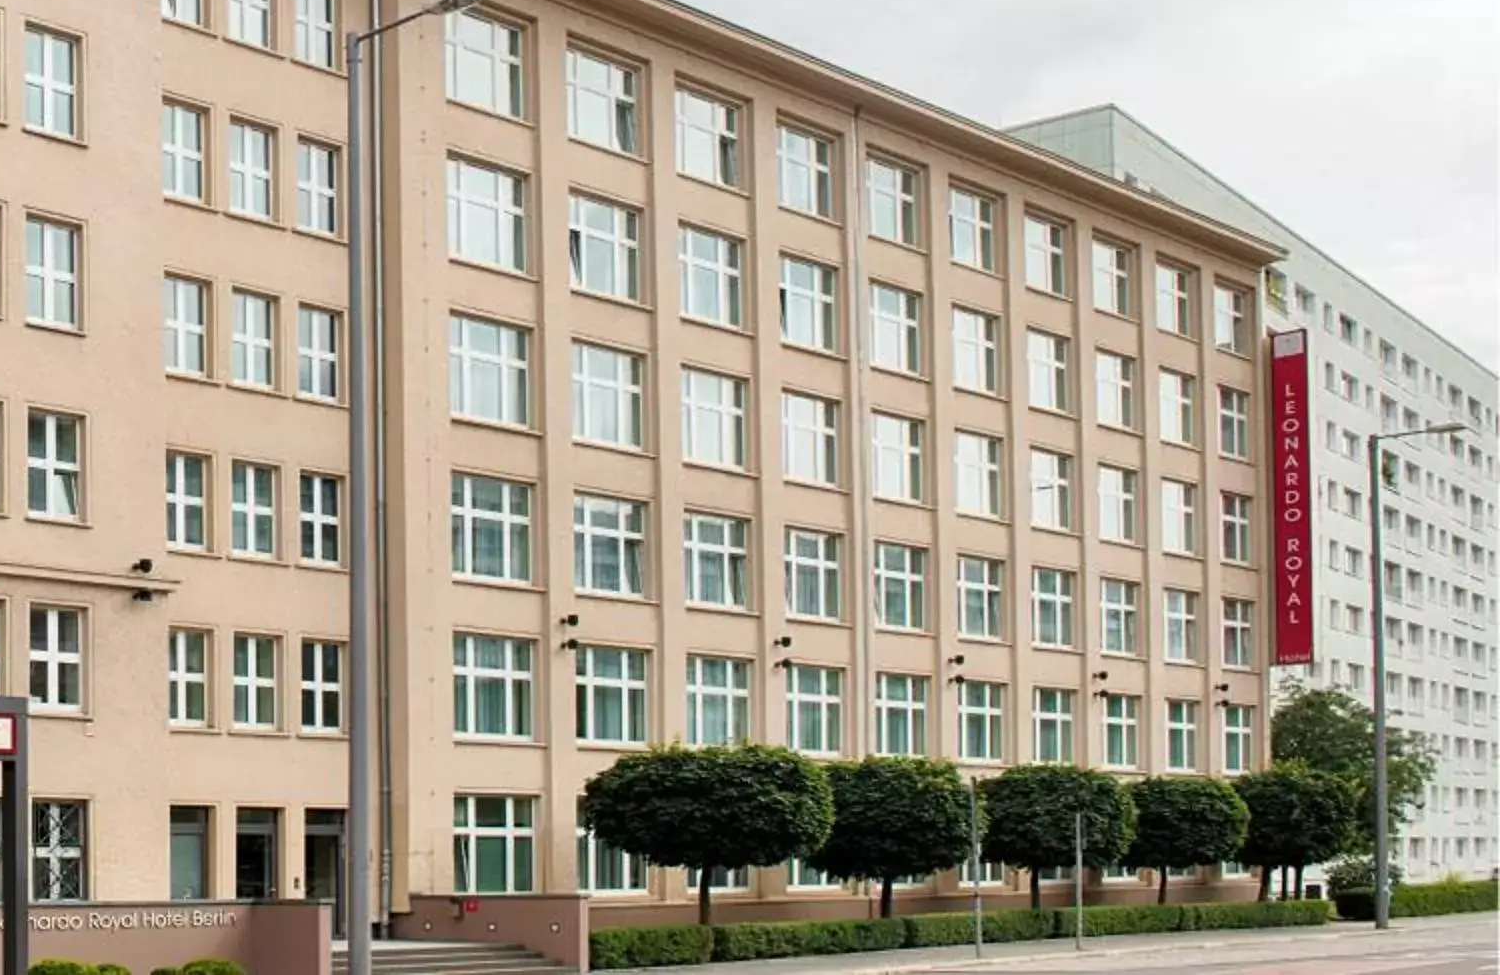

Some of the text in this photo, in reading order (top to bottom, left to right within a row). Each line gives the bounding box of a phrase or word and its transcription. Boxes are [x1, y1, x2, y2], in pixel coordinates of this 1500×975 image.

[1282, 383, 1303, 624] LEONARDO ROYAL
[89, 911, 137, 934] Royal
[143, 910, 188, 928] Hotel
[193, 909, 237, 927] Berlin
